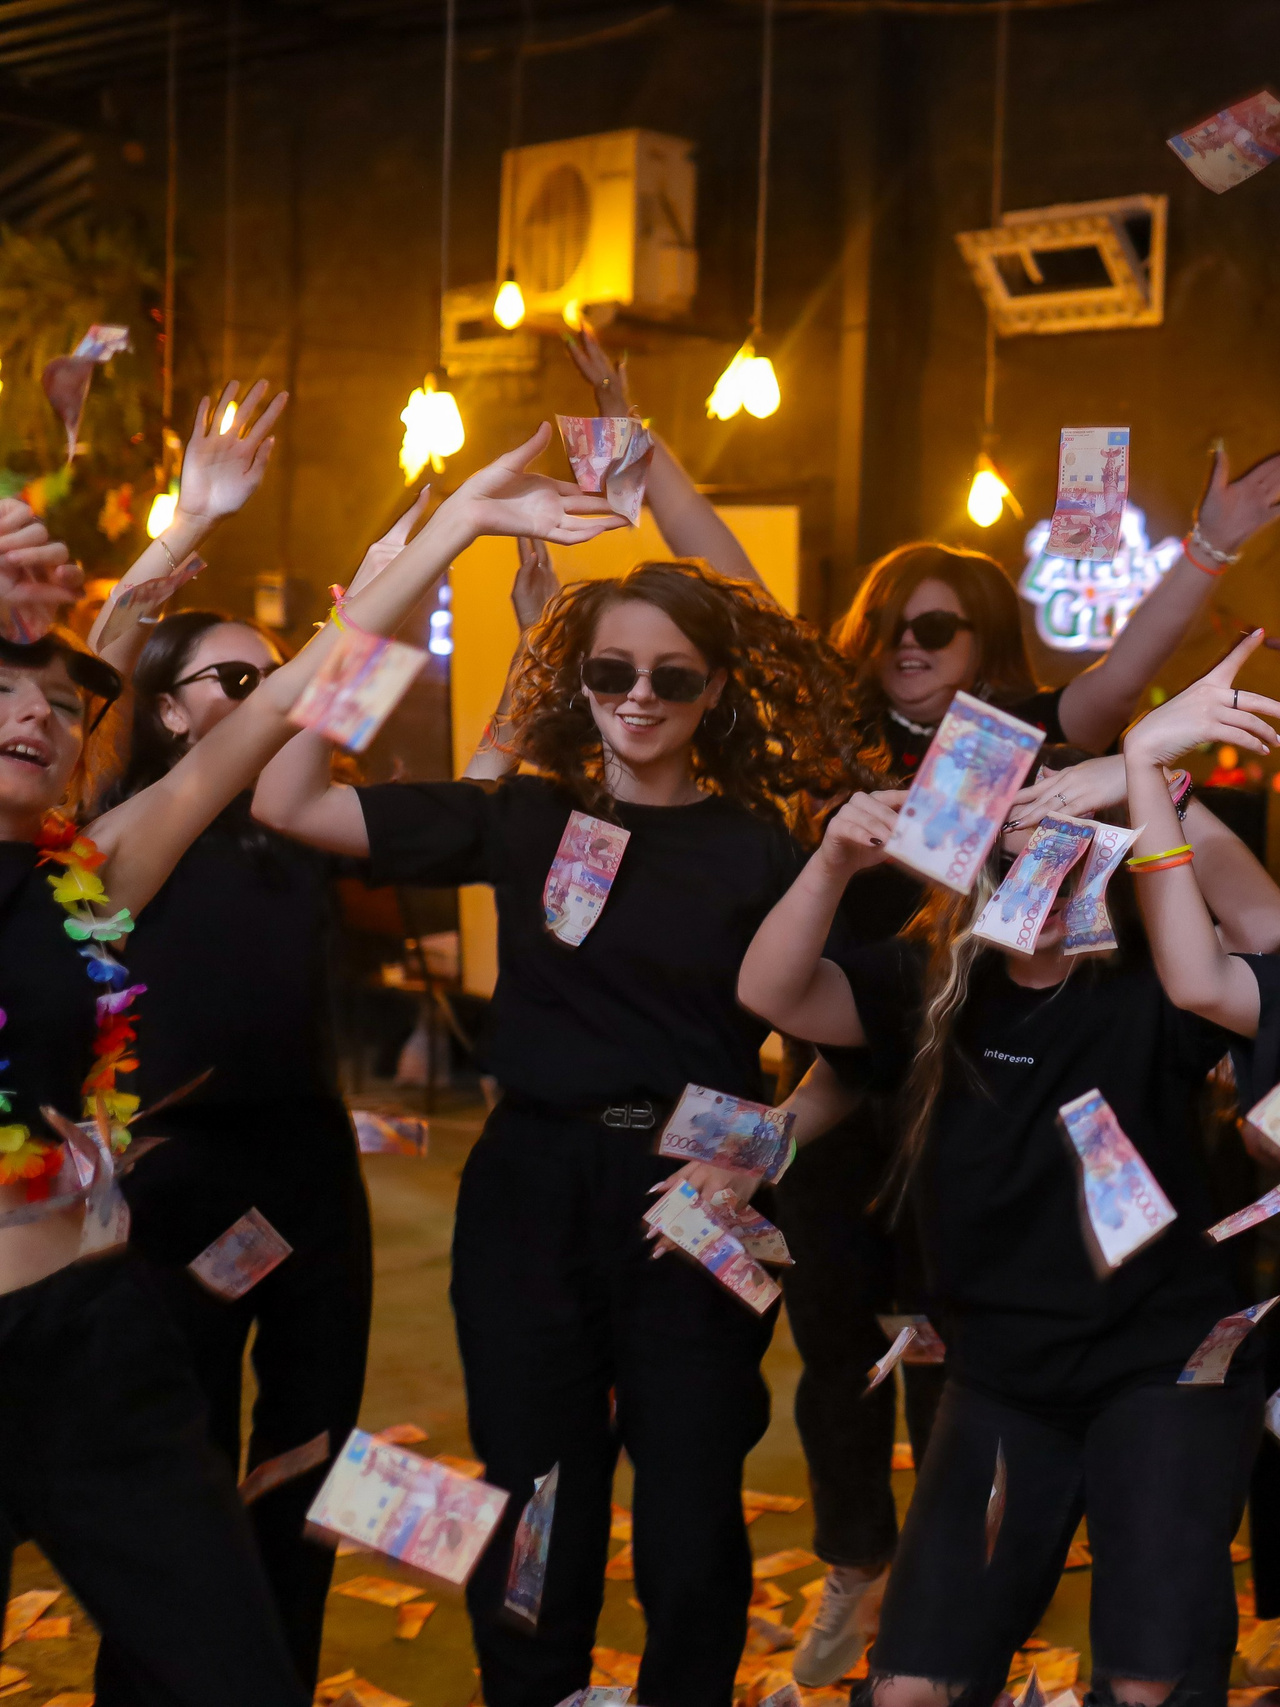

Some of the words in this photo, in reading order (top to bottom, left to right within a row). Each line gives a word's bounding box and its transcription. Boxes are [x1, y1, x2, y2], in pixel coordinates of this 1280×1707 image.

[1016, 908, 1039, 948] 5000
[983, 1048, 1034, 1065] interesno
[663, 1133, 699, 1151] 5000
